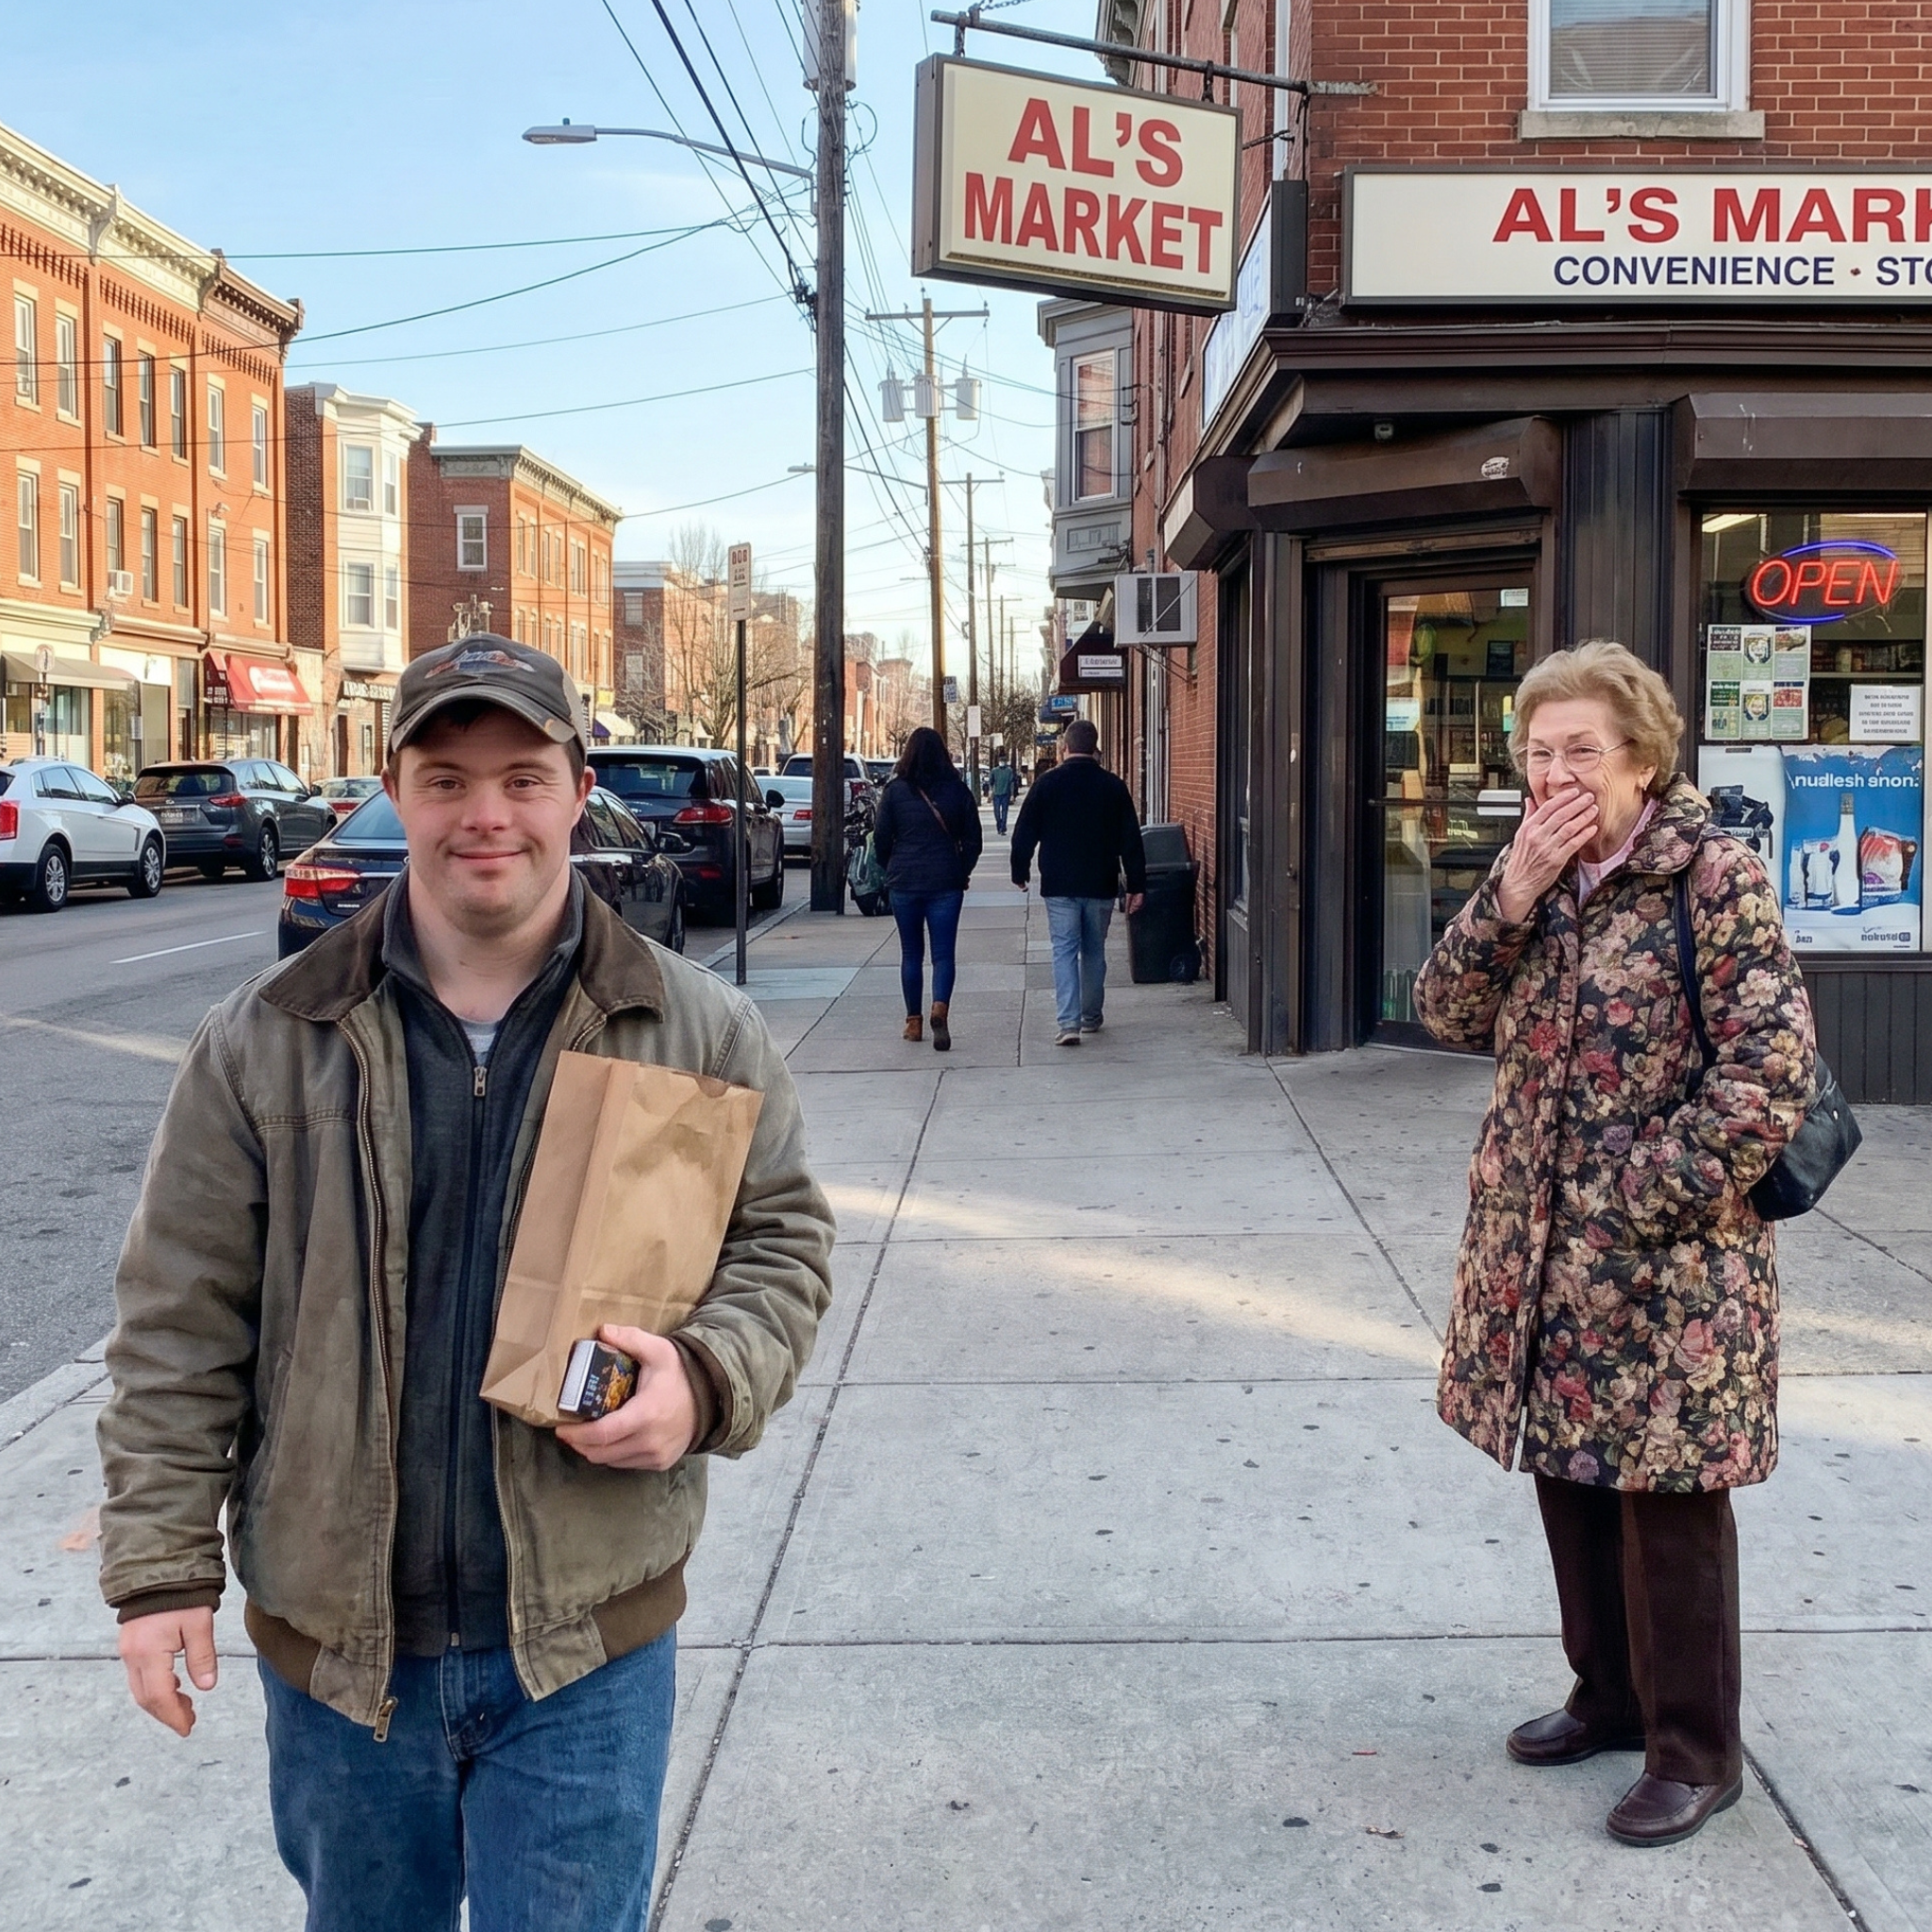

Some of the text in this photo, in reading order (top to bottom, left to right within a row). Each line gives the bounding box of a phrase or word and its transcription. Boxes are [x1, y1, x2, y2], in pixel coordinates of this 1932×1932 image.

[1008, 97, 1183, 188] AL’S
[964, 171, 1224, 275] MARKET
[1492, 187, 1679, 243] AL’S
[1554, 256, 1932, 285] CONVENIENCE ST
[1752, 559, 1899, 606] OPEN
